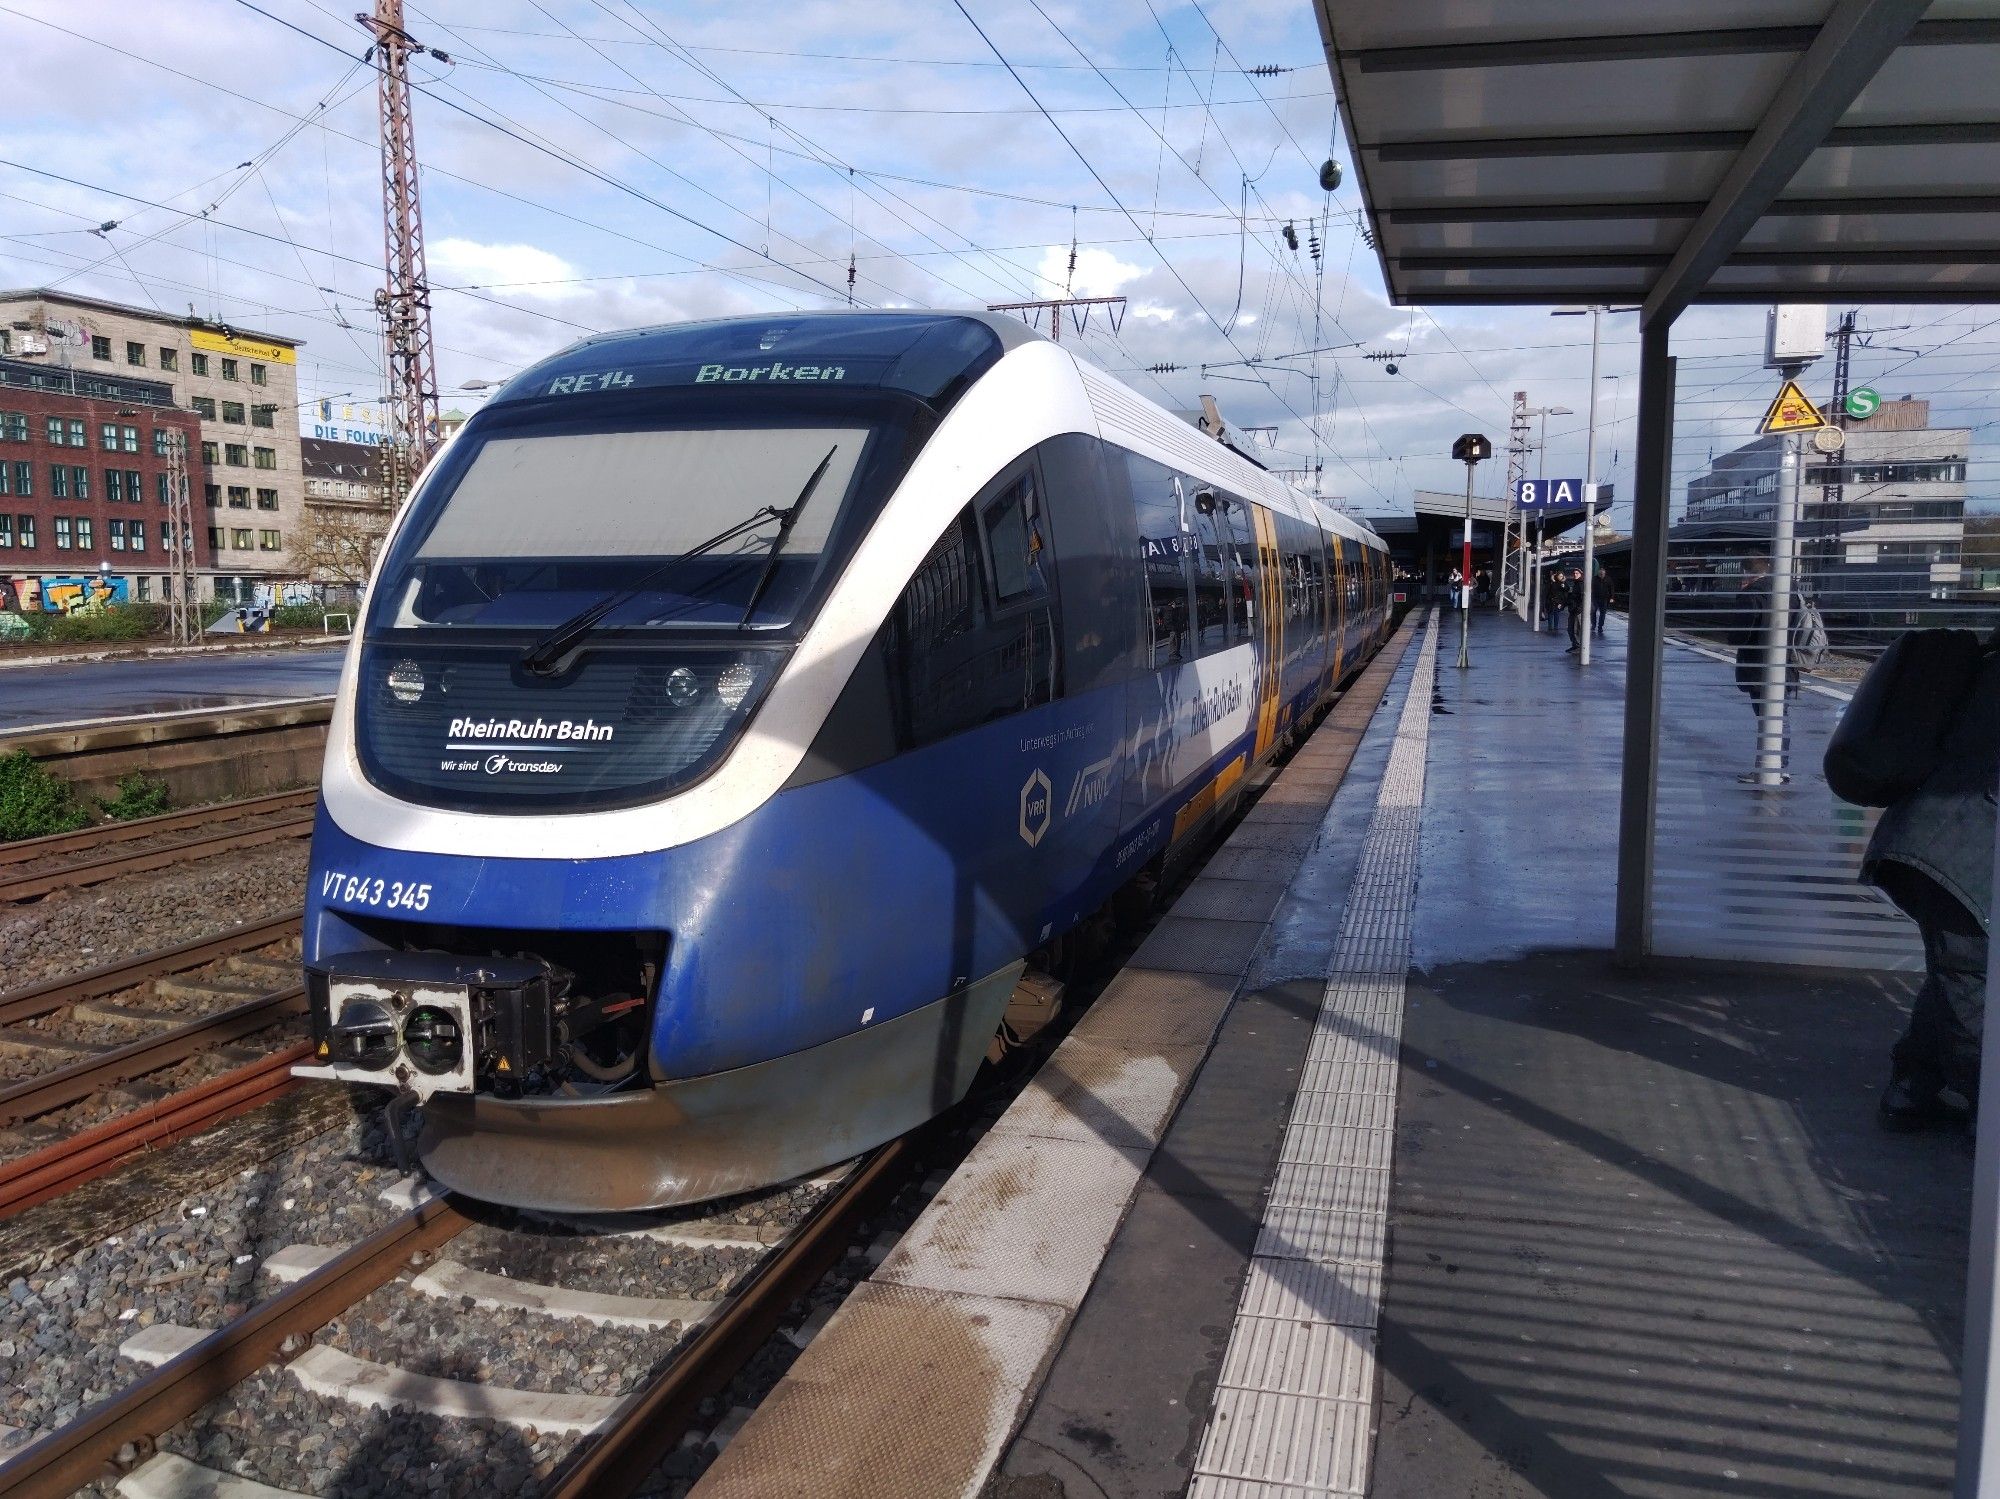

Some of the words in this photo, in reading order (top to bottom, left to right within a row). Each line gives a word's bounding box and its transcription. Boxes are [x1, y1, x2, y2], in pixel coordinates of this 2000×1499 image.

[695, 362, 846, 384] Borken
[1852, 390, 1873, 414] S
[314, 424, 339, 440] DIE
[1521, 482, 1536, 503] 8
[1554, 481, 1573, 503] A
[448, 717, 614, 741] RheinRuhrBahn
[441, 760, 457, 771] Wir
[458, 760, 479, 771] sind
[507, 760, 563, 773] transdev
[322, 870, 347, 900] VT
[344, 876, 385, 906] 643
[387, 882, 433, 911] 345
